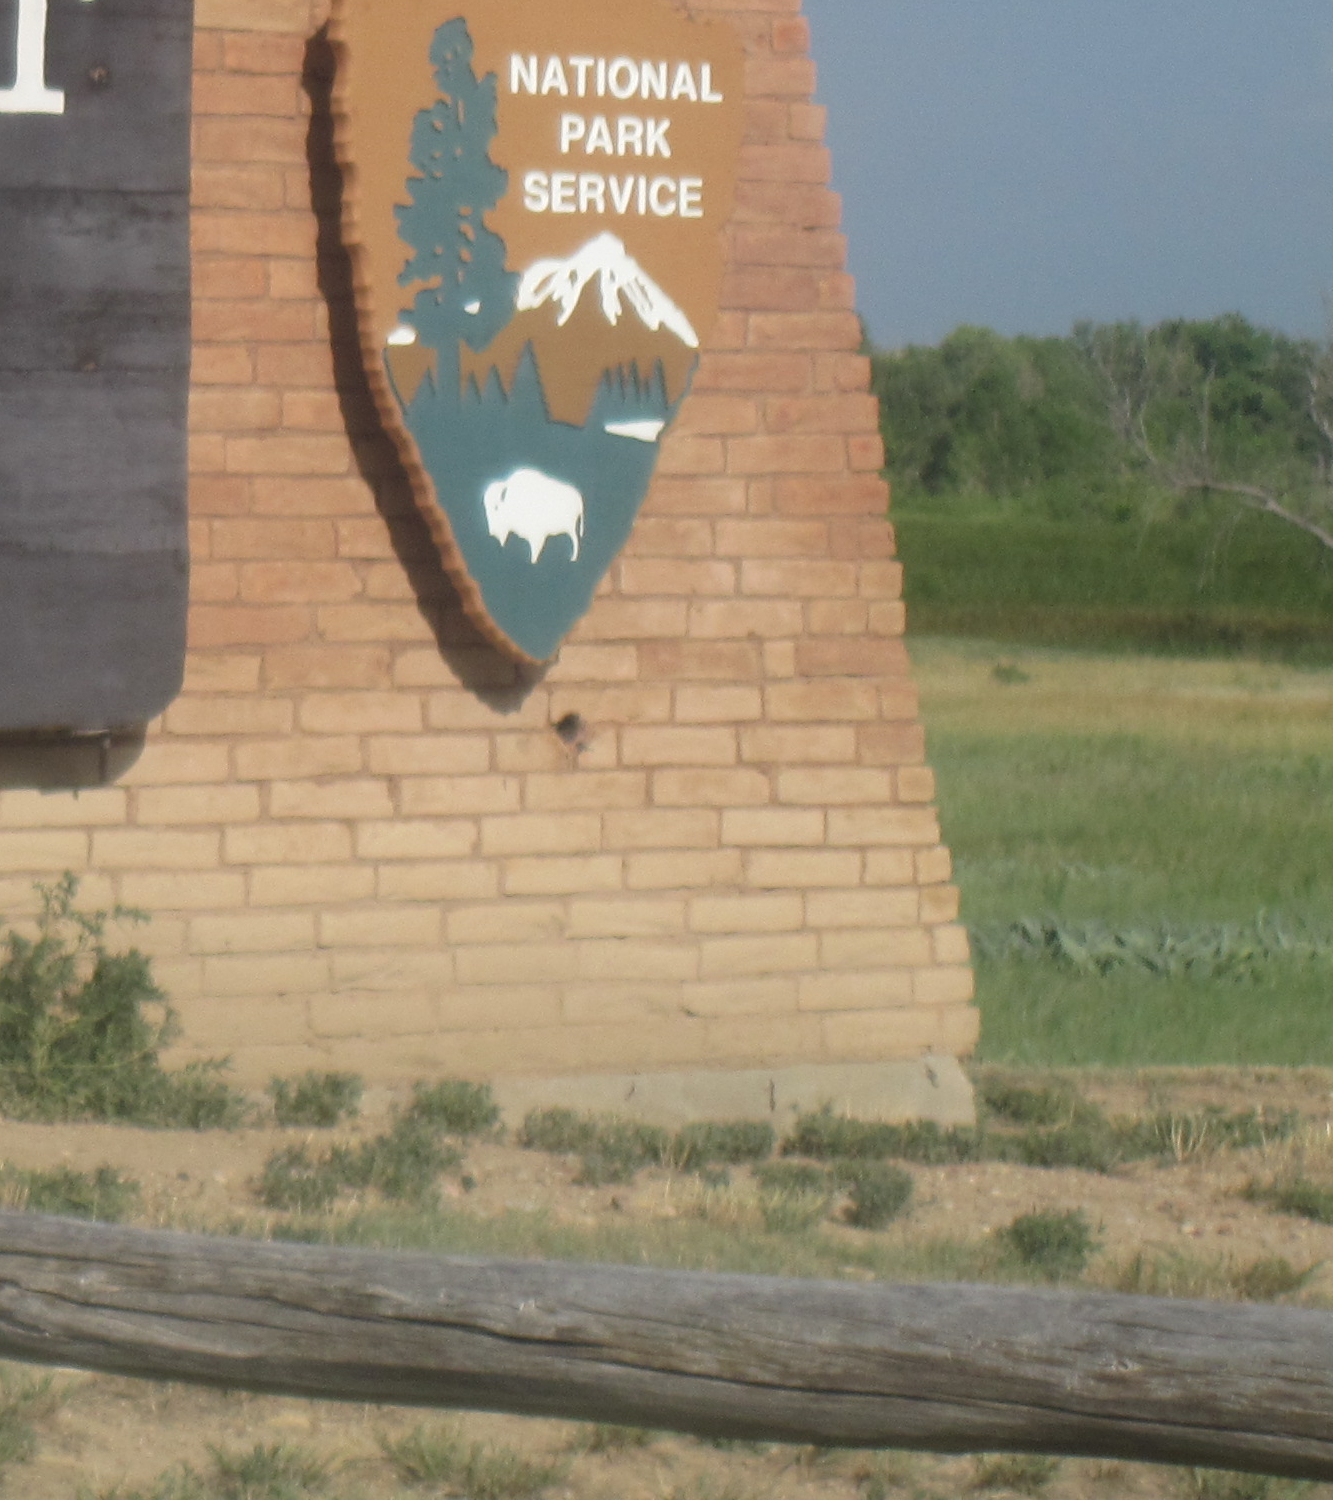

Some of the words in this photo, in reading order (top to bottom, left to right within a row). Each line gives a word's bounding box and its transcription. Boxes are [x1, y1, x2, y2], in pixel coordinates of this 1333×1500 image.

[510, 53, 723, 103] NATIONAL
[560, 113, 671, 159] PARK
[523, 170, 704, 218] SERVICE
